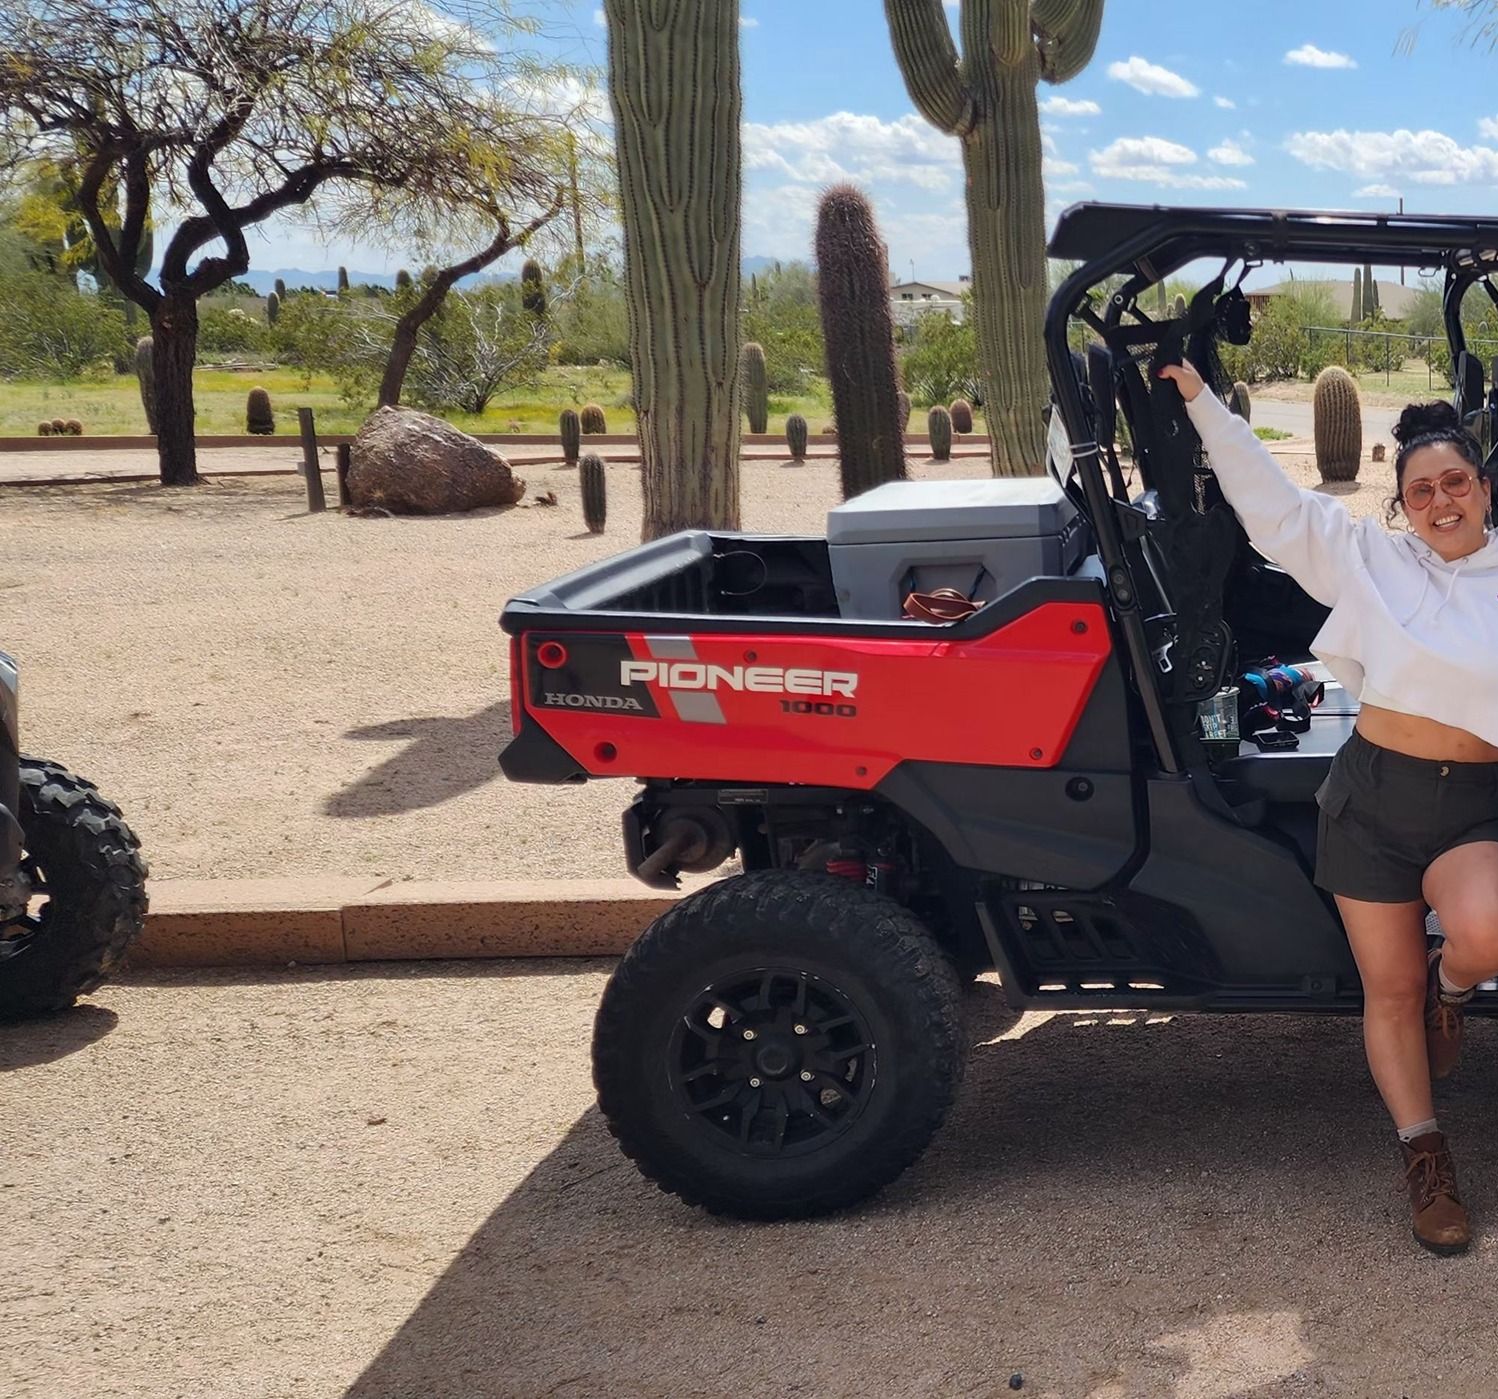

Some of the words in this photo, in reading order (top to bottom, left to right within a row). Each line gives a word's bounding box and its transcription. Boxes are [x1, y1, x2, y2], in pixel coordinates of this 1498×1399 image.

[620, 660, 858, 698] PIONEER
[544, 692, 643, 710] HONDA
[779, 700, 857, 718] 1000
